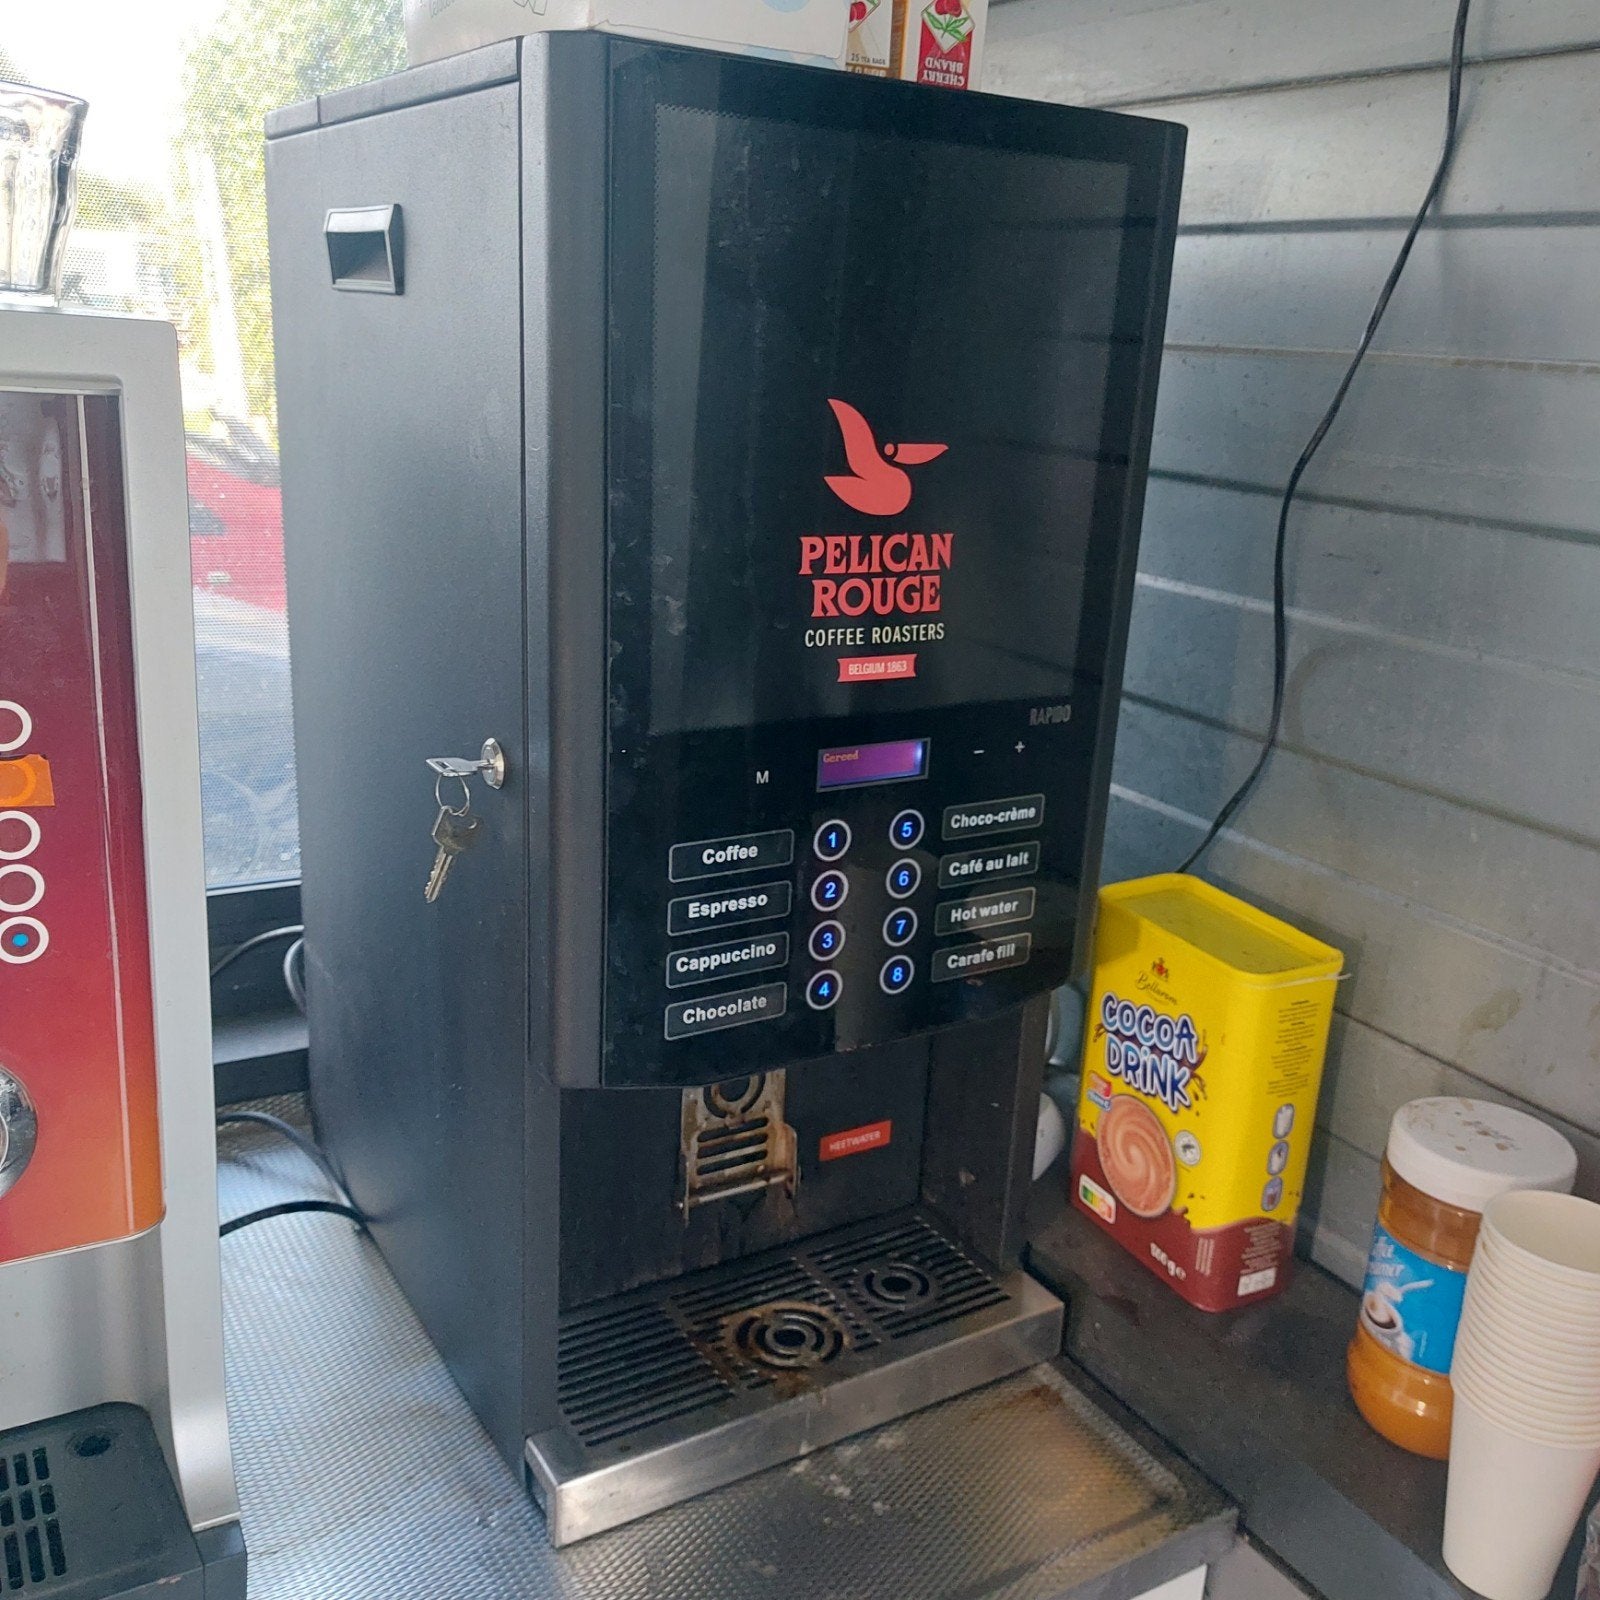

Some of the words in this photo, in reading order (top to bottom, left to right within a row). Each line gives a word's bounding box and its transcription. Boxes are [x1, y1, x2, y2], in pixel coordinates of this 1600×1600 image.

[851, 53, 859, 61] 25
[925, 57, 963, 74] BRAND
[922, 70, 965, 87] CHERRY
[798, 533, 954, 575] PELICAN
[811, 575, 941, 617] ROUGE
[805, 628, 865, 647] COFFEE
[871, 623, 945, 643] ROASTERS
[848, 662, 885, 675] BELGIUM
[756, 770, 769, 785] M
[950, 806, 1036, 829] Choco-crème
[901, 821, 913, 838] 5
[828, 832, 837, 848] 1
[702, 844, 759, 865] Coffee
[949, 858, 983, 877] Café
[985, 858, 1004, 871] au
[1006, 851, 1029, 868] lait
[898, 870, 910, 886] 6
[825, 881, 837, 898] 2
[688, 894, 768, 919] Espresso
[950, 906, 977, 922] Hot
[979, 900, 1019, 917] water
[895, 919, 907, 935] 7
[822, 932, 834, 949] 3
[675, 943, 777, 972] Cappuccino
[947, 948, 995, 968] Carafe
[996, 943, 1016, 959] fill
[892, 966, 904, 983] 8
[818, 981, 830, 997] 4
[682, 995, 767, 1024] Chocolate
[1101, 992, 1197, 1064] COCOA
